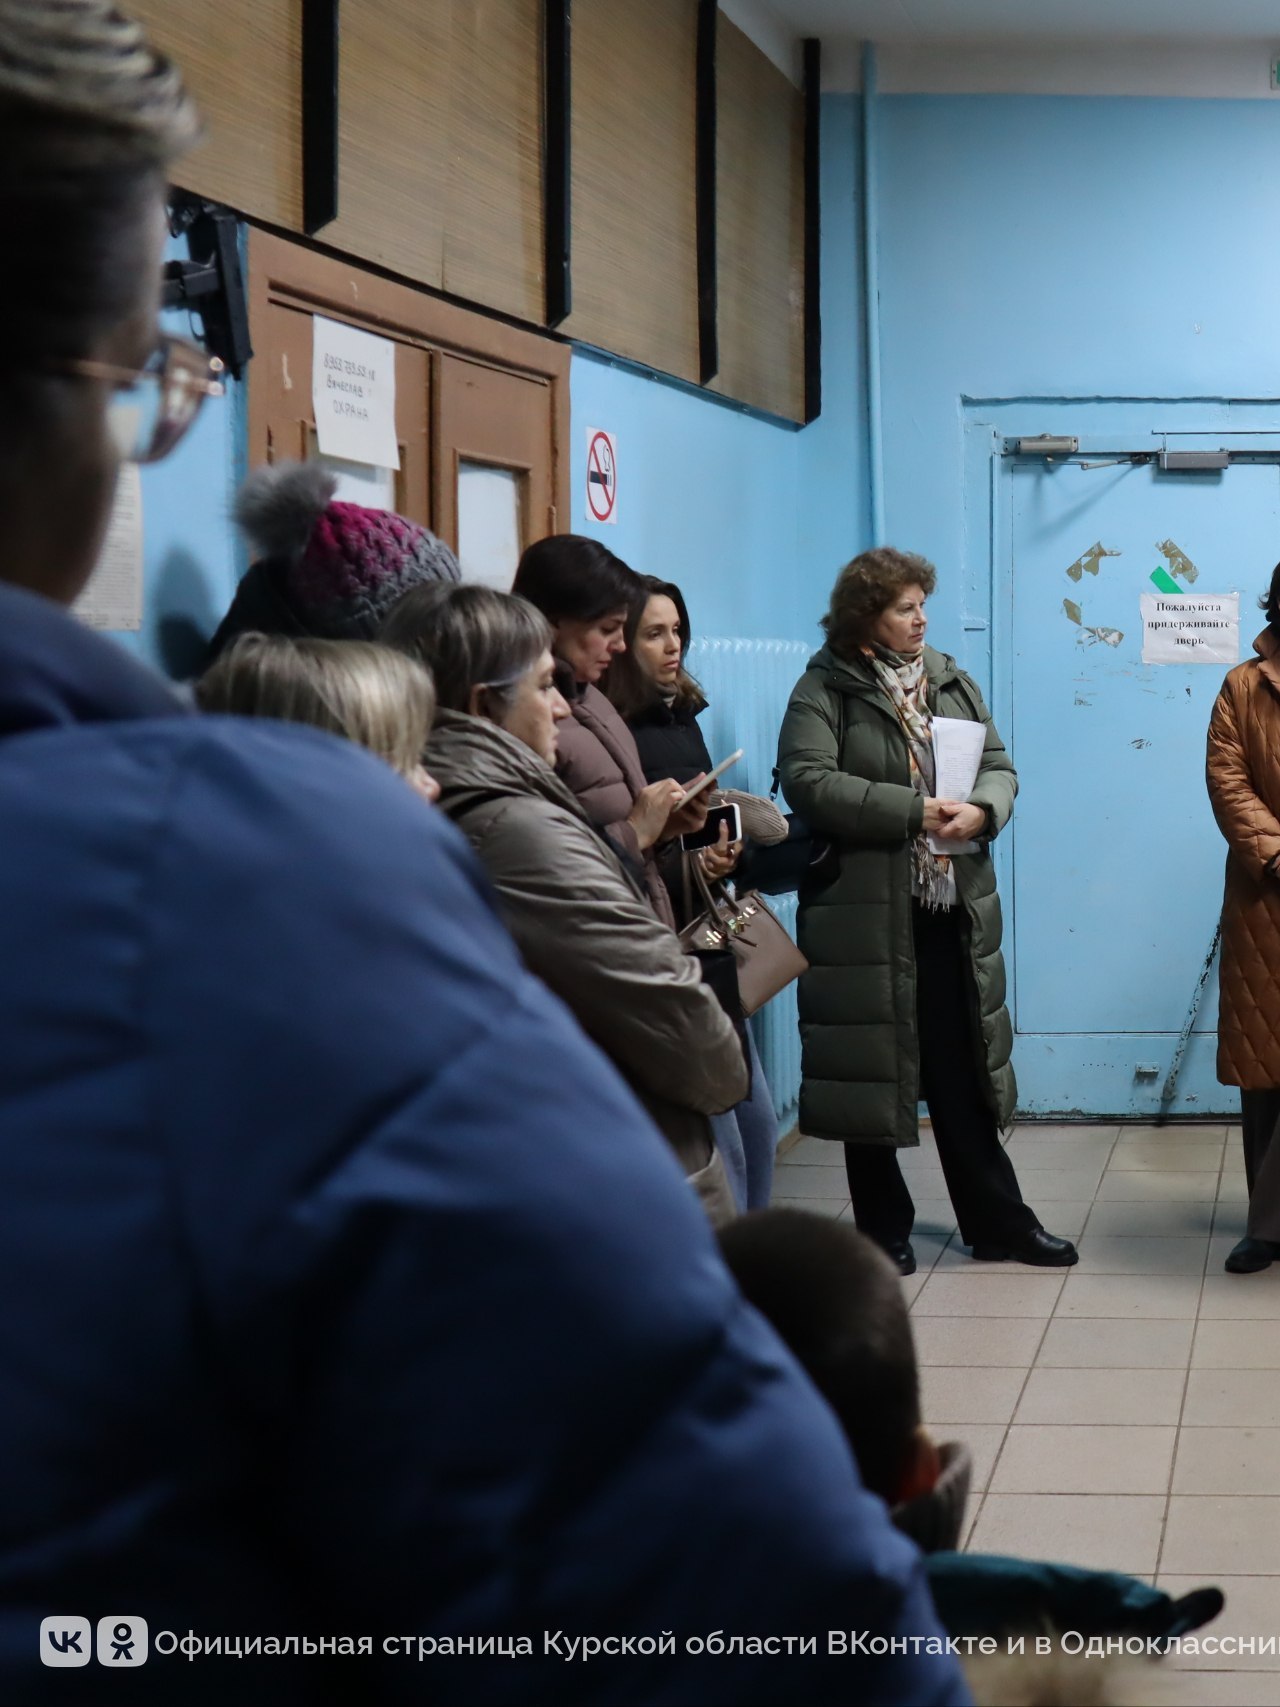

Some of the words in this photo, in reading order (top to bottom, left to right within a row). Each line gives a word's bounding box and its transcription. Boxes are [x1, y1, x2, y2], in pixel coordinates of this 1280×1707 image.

[333, 399, 369, 421] ОХРАНА
[1156, 602, 1221, 614] Пожалуйста
[1147, 619, 1230, 631] придерживайте
[1173, 637, 1204, 647] дверь
